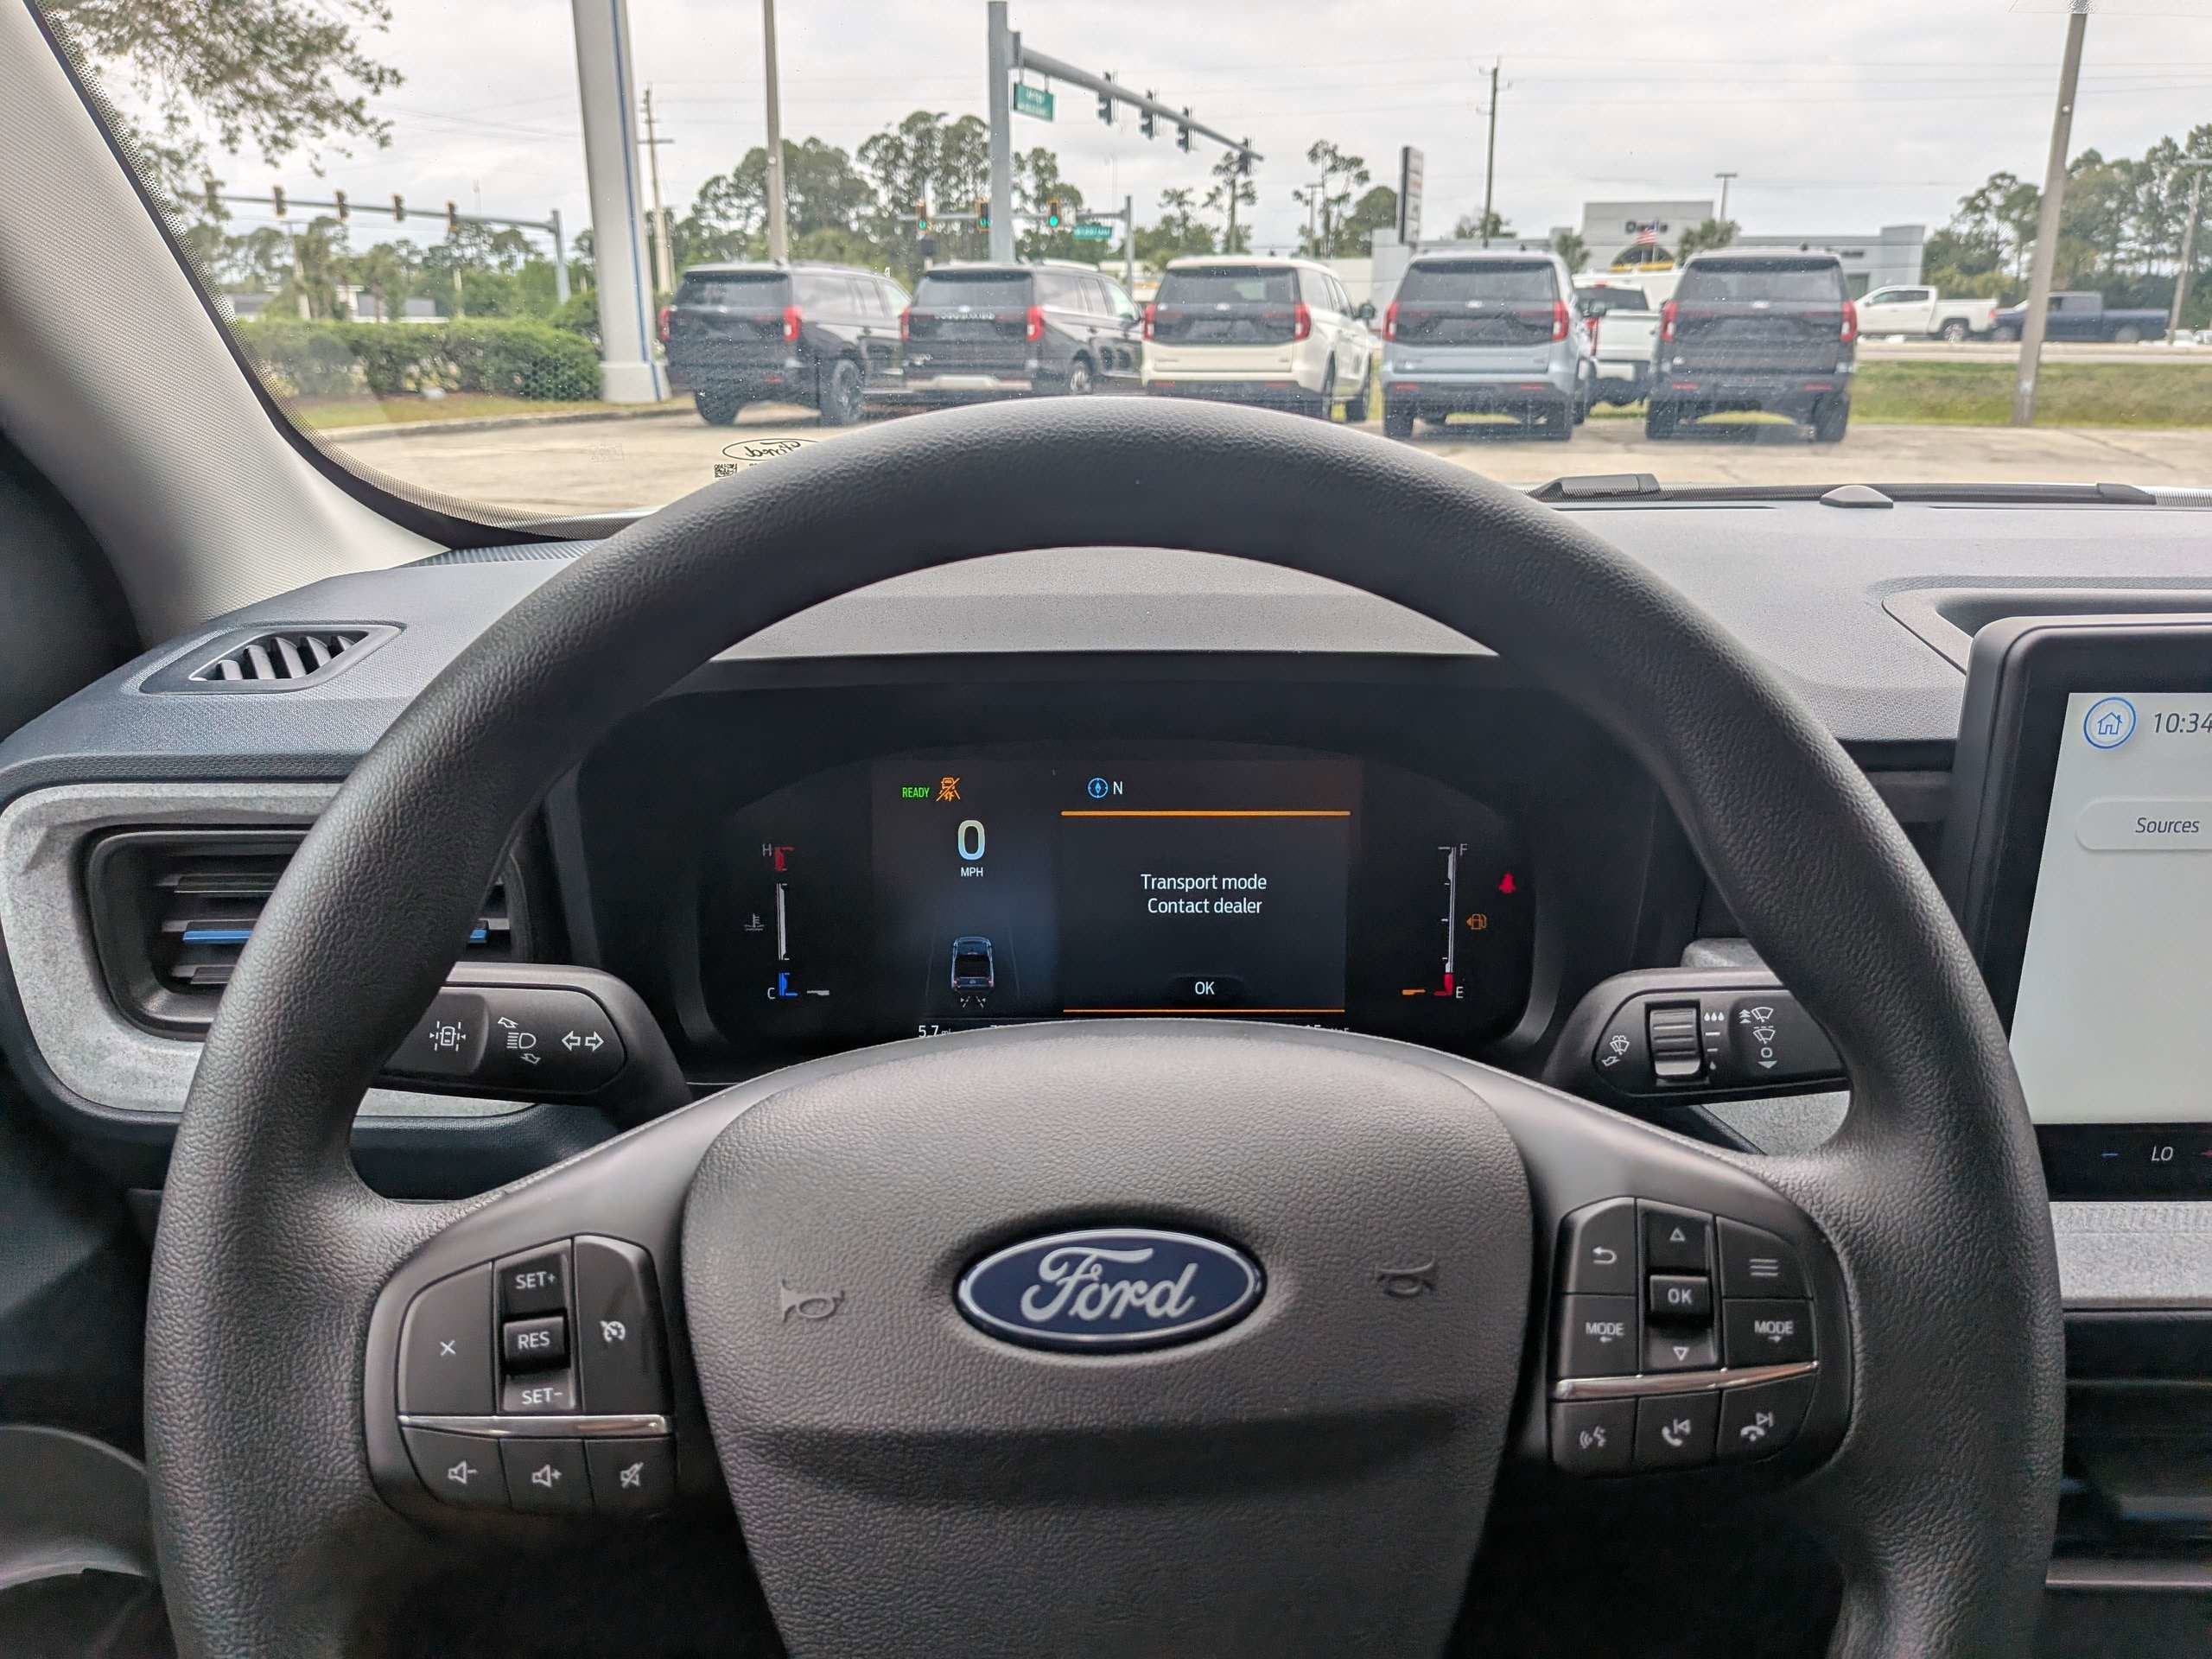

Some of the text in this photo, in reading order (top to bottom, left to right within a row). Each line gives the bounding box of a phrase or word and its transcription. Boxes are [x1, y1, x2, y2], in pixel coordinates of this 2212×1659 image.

[901, 786, 931, 798] READY
[1113, 780, 1123, 795] N
[2135, 817, 2200, 834] Sources
[957, 819, 986, 861] 0
[762, 843, 772, 856] H
[1459, 842, 1469, 856] F
[960, 867, 984, 877] MPH
[1141, 873, 1267, 892] Transport mode
[1147, 897, 1262, 913] Contact dealer
[766, 987, 776, 1000] C
[1194, 981, 1215, 995] OK
[1455, 986, 1464, 999] E
[2151, 1146, 2174, 1162] LO
[516, 1271, 556, 1289] SET+
[1020, 1246, 1198, 1322] Ford
[1668, 1287, 1693, 1304] OK
[1586, 1322, 1624, 1337] MODE
[1754, 1319, 1794, 1336] MODE
[518, 1331, 550, 1350] RES
